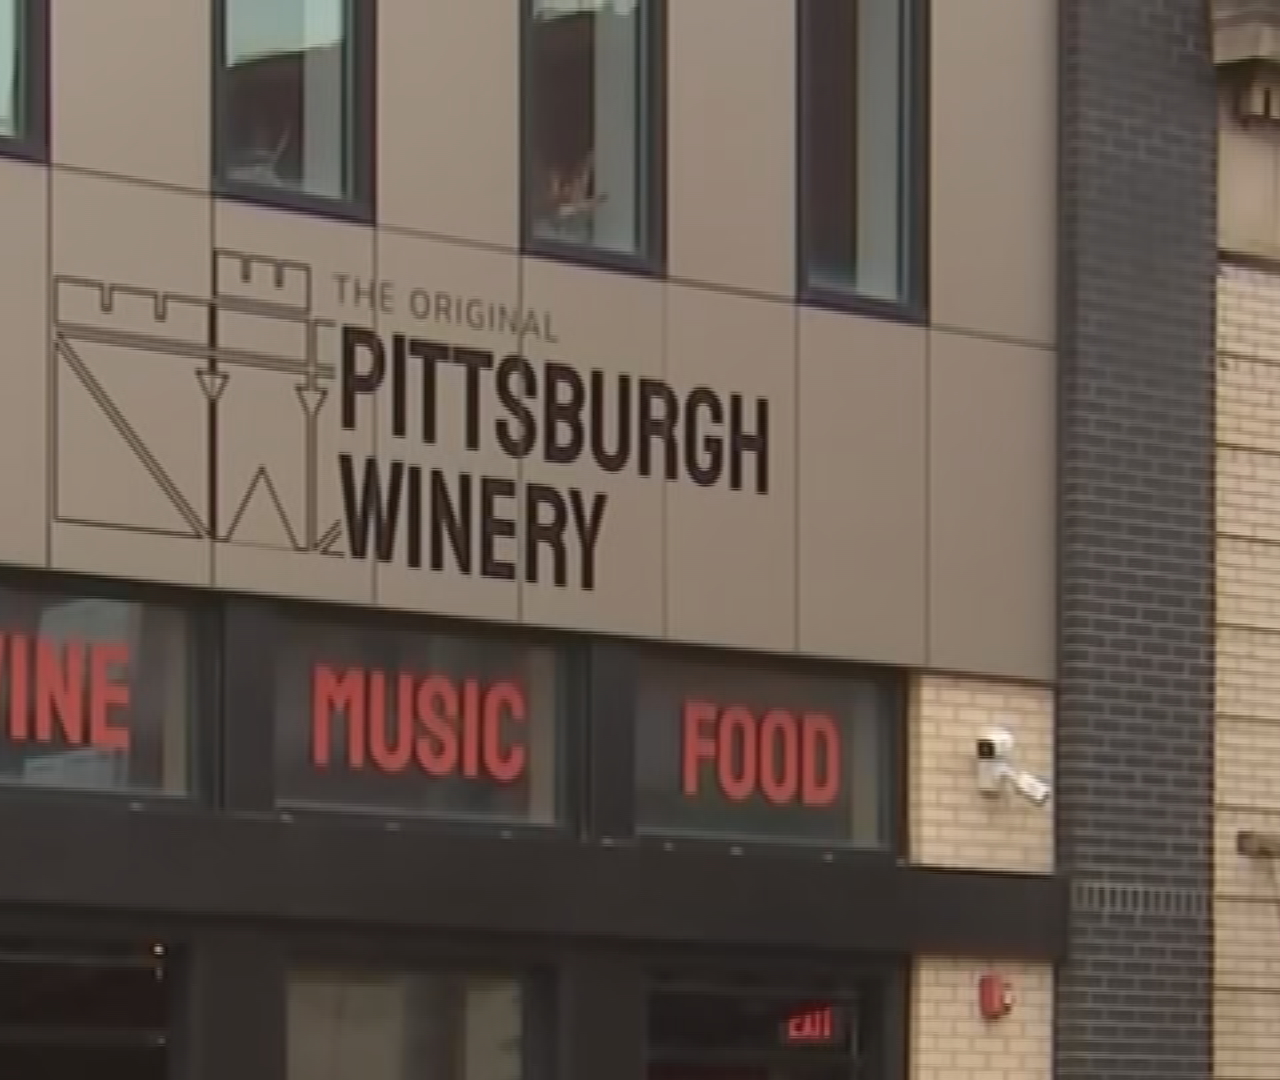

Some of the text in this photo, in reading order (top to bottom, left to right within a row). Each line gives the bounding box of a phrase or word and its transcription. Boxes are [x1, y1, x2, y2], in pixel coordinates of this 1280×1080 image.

[331, 271, 559, 344] THE ORIGINAL
[340, 324, 771, 496] PITTSBURGH
[338, 452, 608, 591] WINERY
[311, 662, 527, 783] MUSIC
[680, 700, 842, 806] FOOD
[789, 1007, 831, 1039] EXIT
